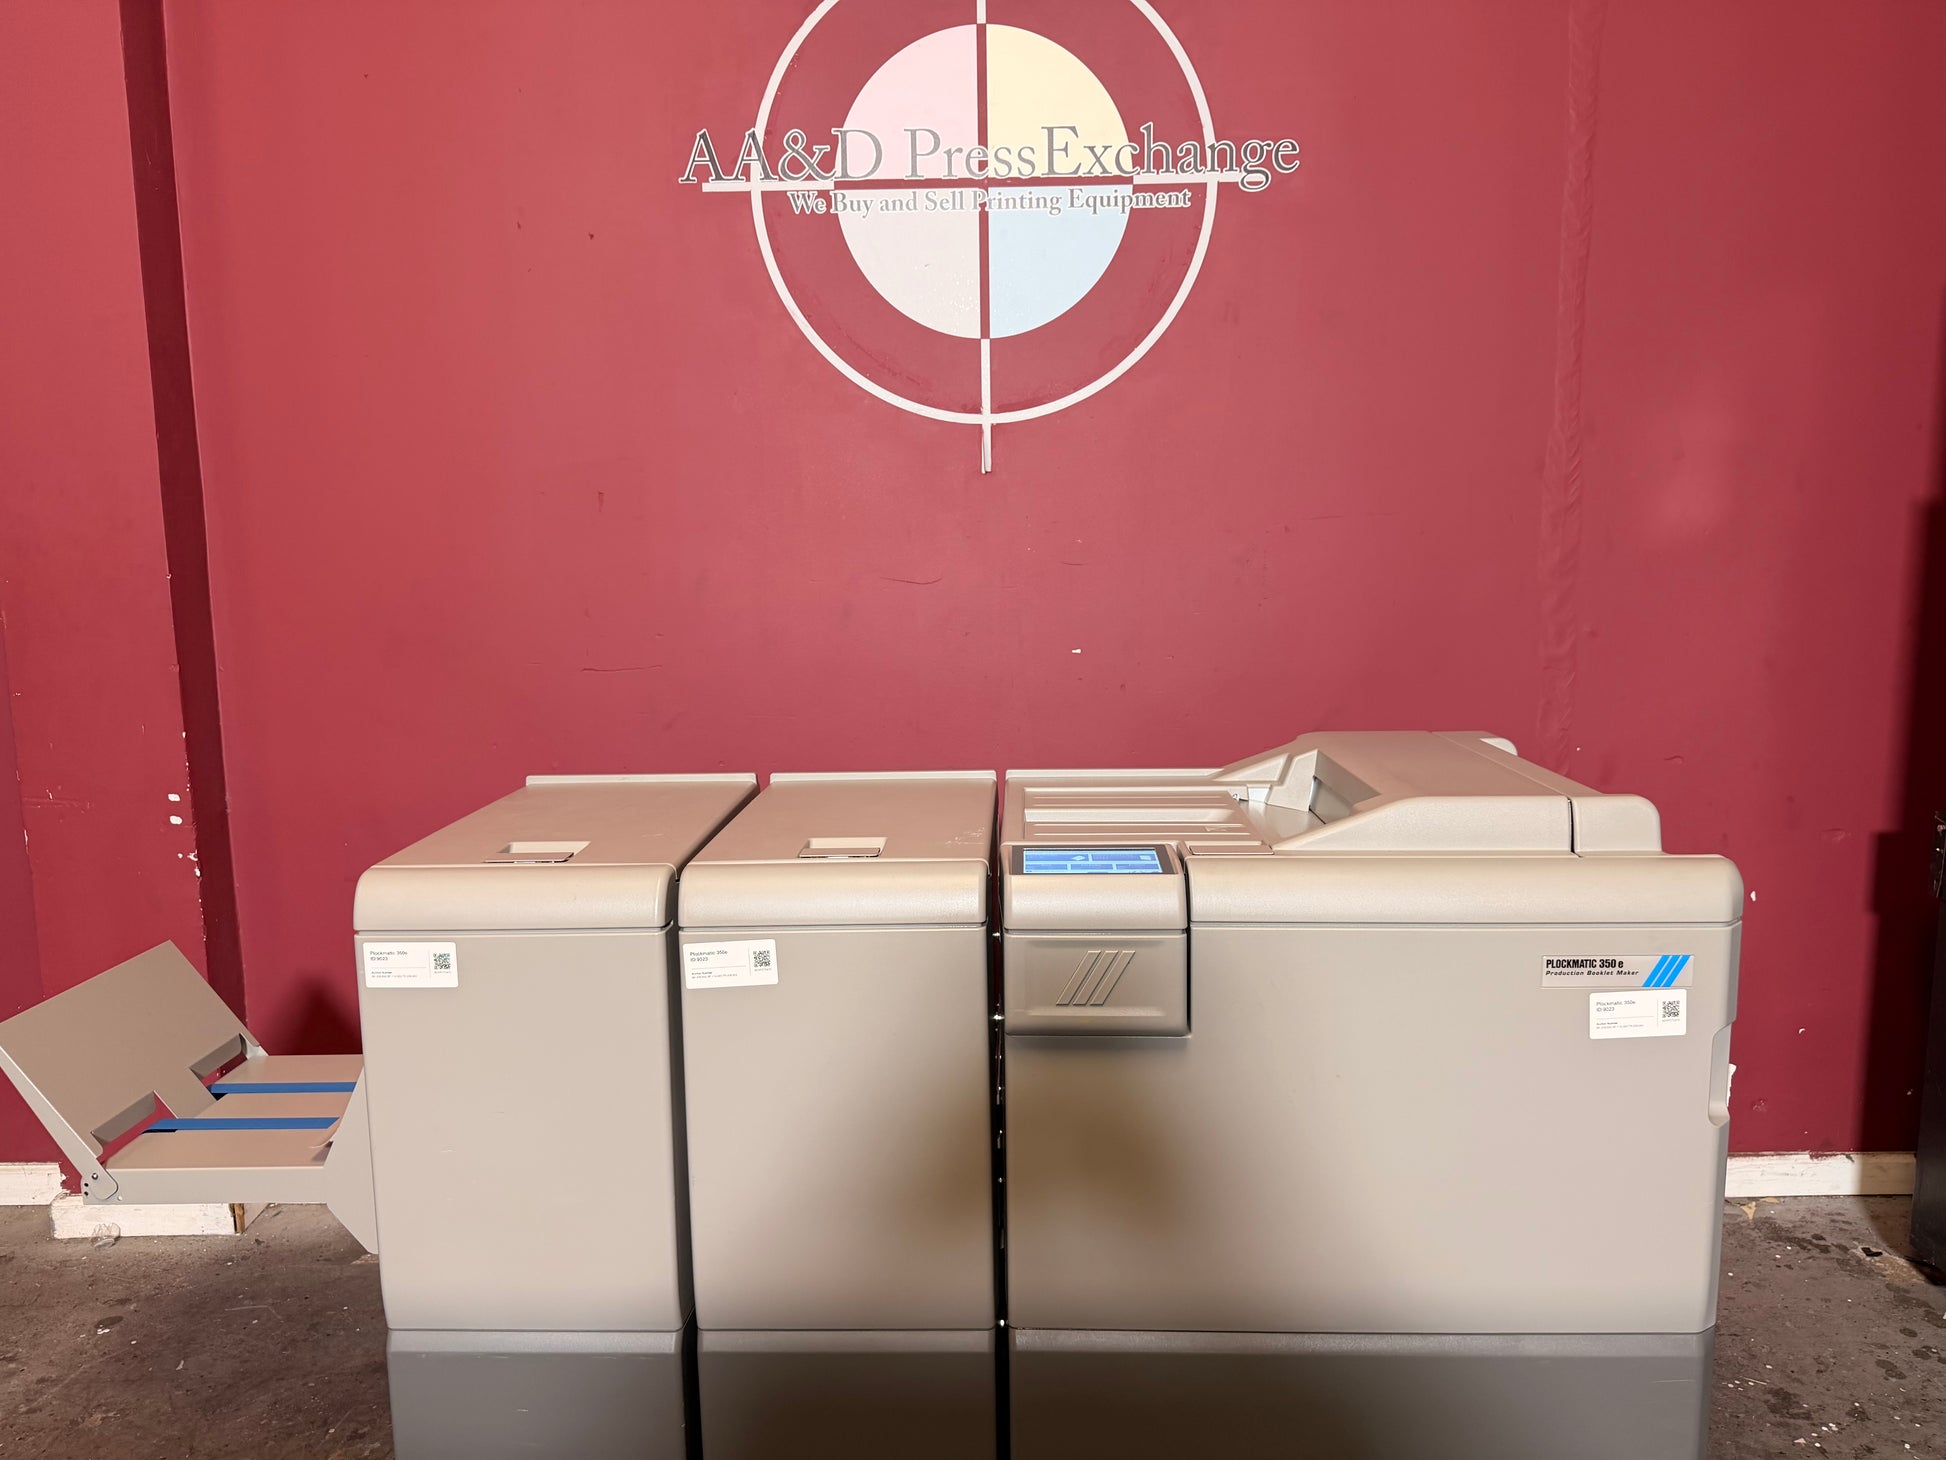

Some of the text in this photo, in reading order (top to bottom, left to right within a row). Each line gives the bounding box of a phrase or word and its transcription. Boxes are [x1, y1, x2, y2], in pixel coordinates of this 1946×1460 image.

[679, 121, 1300, 192] AA&D PressExchange
[787, 186, 1192, 219] We Buy and Sell Printing Equipment
[1545, 958, 1624, 969] PLOCKMATIC 350 e
